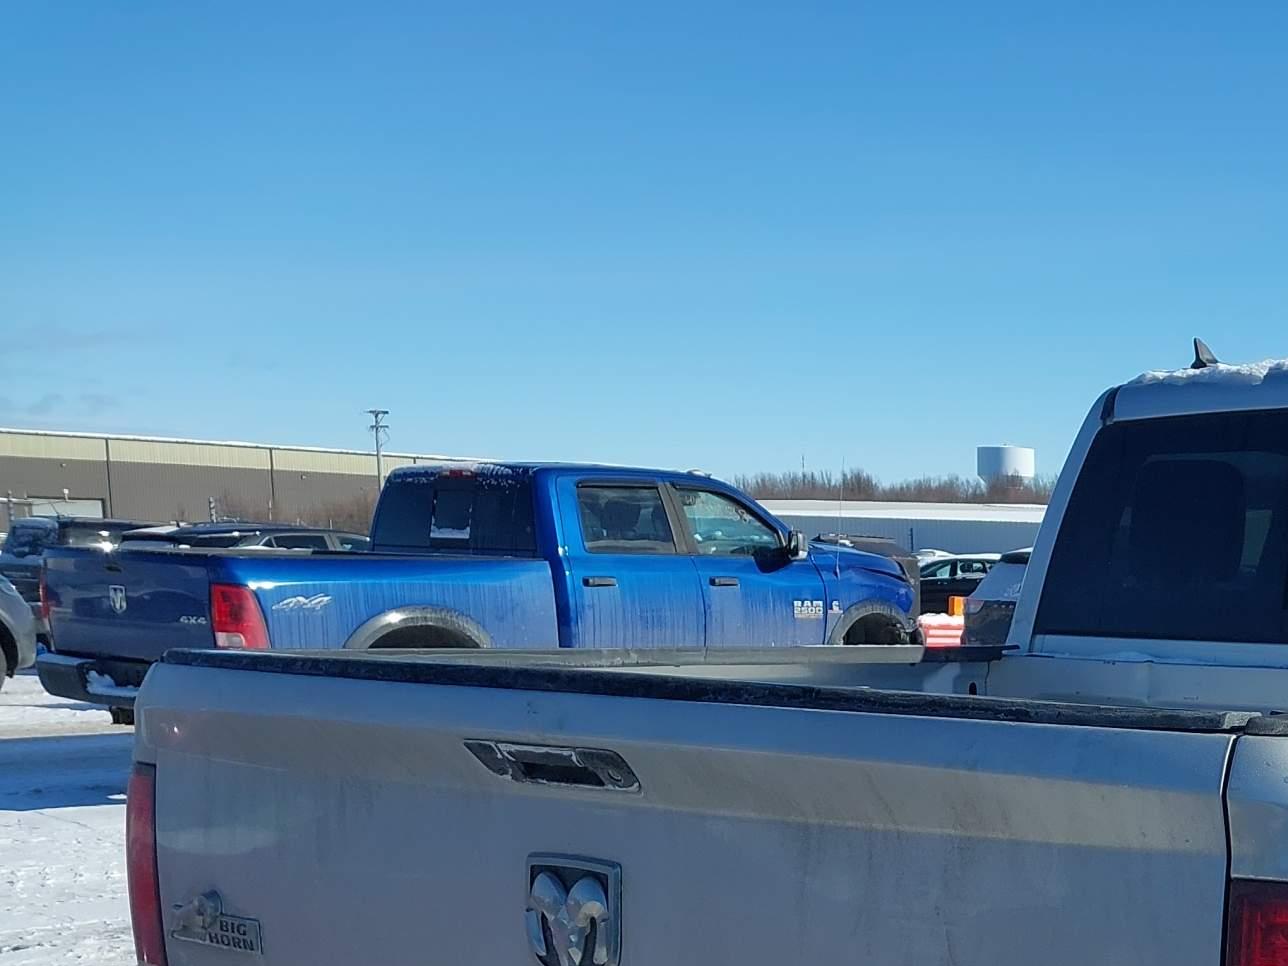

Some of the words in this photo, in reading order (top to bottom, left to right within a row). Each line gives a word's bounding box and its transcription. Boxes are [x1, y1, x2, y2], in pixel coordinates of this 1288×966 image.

[793, 600, 823, 608] RAM
[219, 919, 248, 936] BIG
[207, 933, 255, 951] HORN
